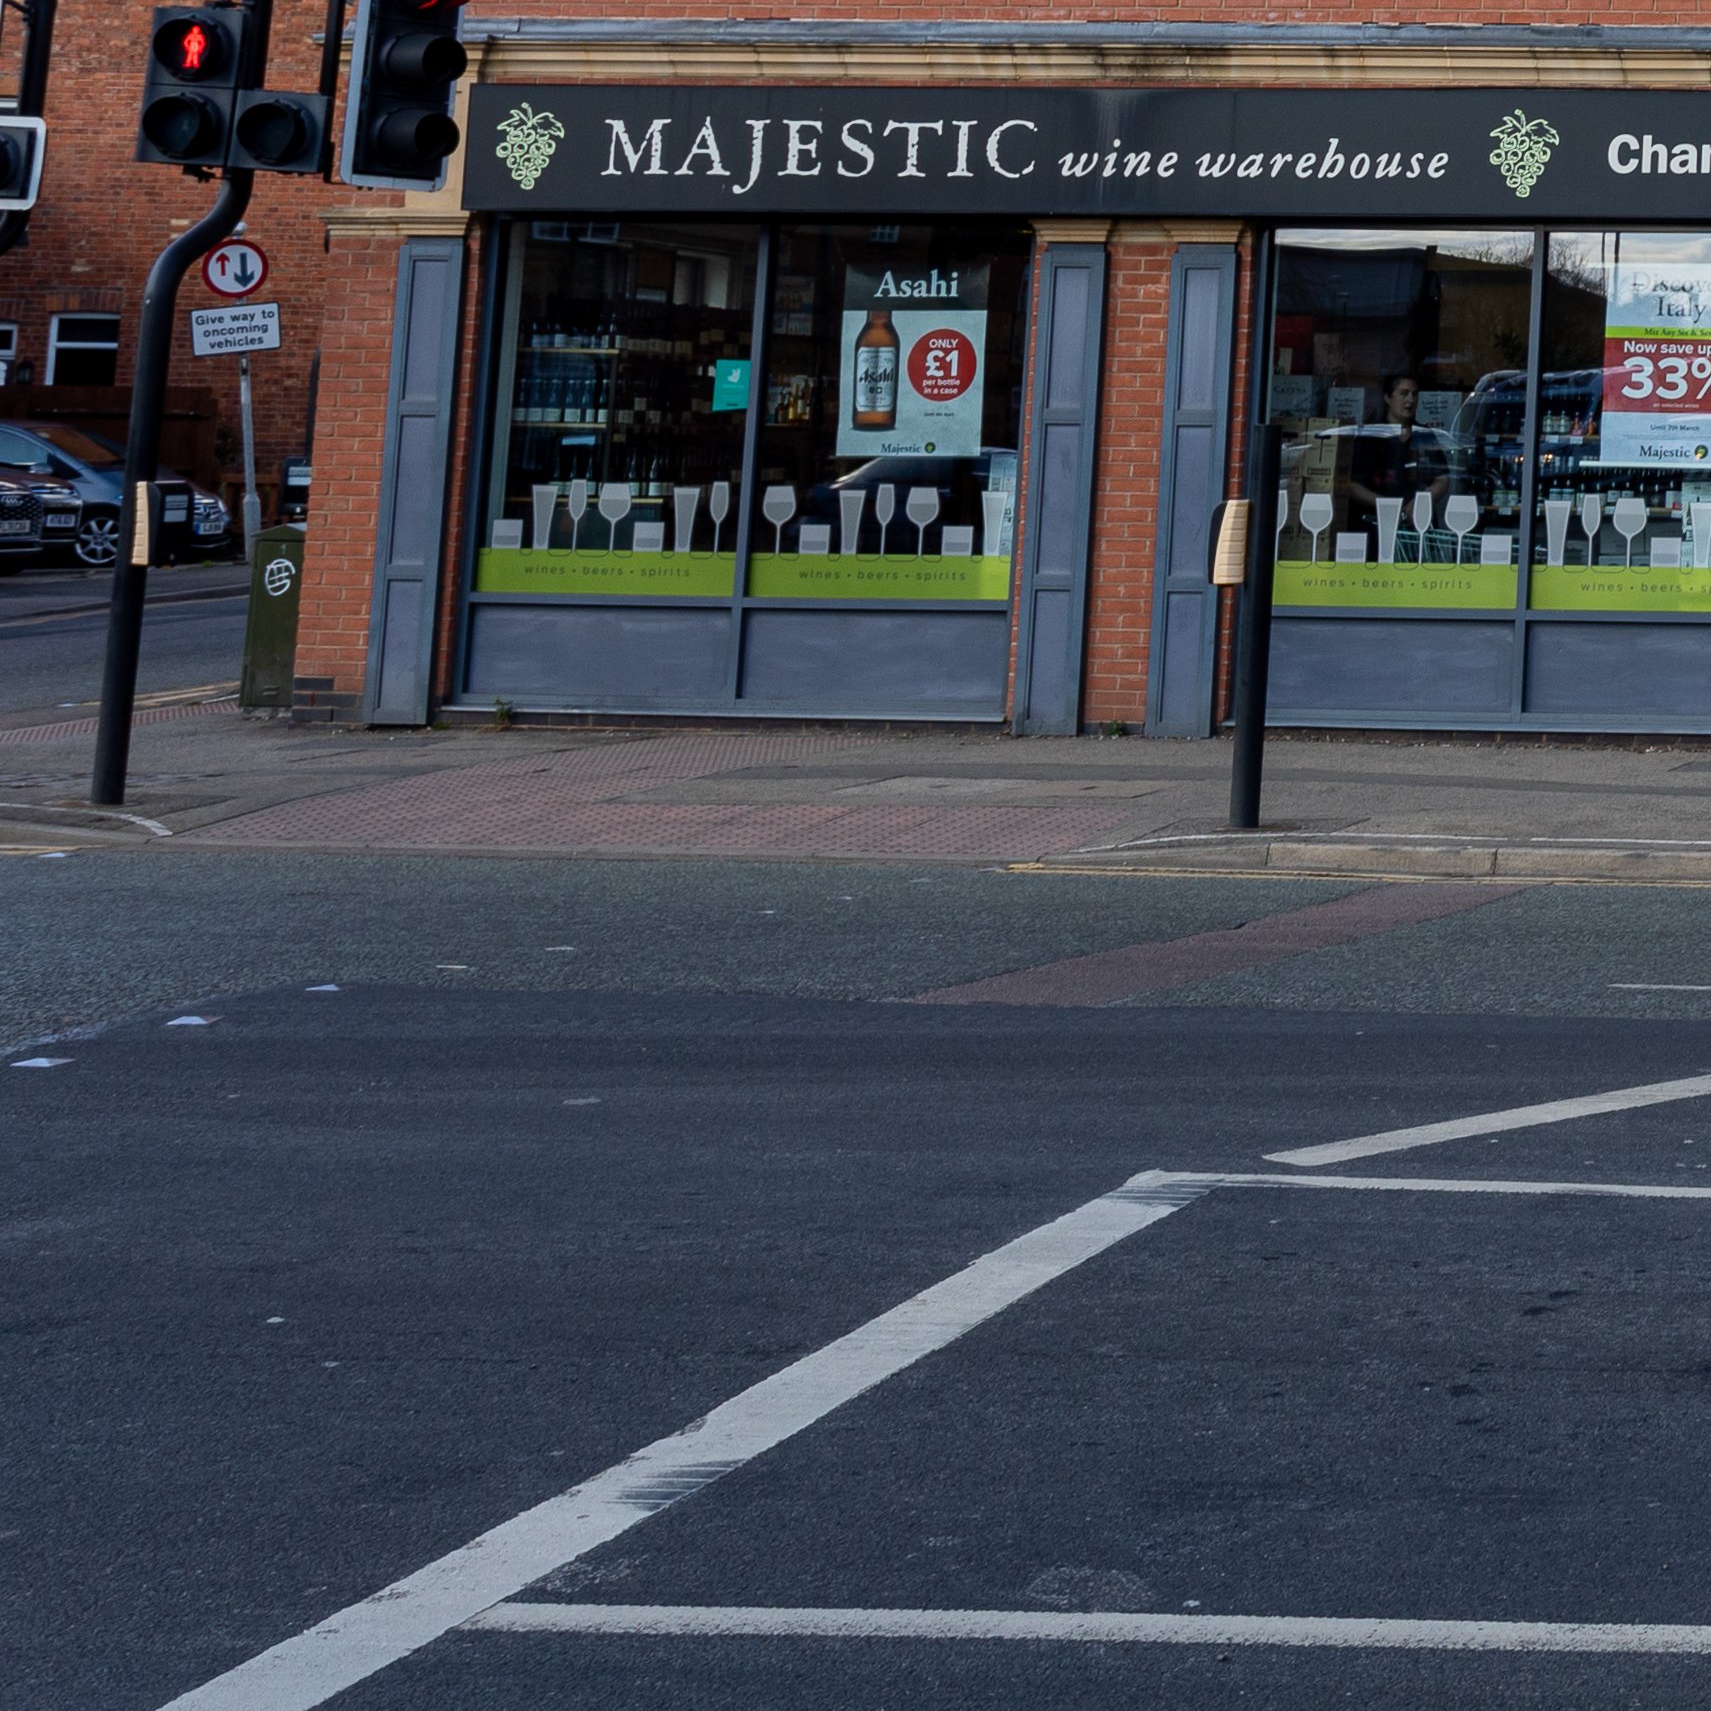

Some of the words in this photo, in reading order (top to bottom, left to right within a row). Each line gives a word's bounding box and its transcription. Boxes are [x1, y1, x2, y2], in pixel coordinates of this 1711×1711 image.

[600, 115, 1038, 194] MAJESTIC
[1057, 138, 1179, 177] wine
[1195, 137, 1449, 179] warehouse
[873, 268, 959, 298] Asahi
[1657, 296, 1707, 324] Italy
[195, 314, 224, 326] Give
[230, 312, 256, 322] way
[261, 309, 275, 319] to
[203, 323, 269, 338] oncoming
[209, 335, 264, 349] vehicles
[929, 338, 959, 349] ONLY
[1623, 340, 1657, 354] Now
[1660, 343, 1694, 354] save
[925, 350, 960, 378] £1
[922, 379, 936, 387] per
[937, 378, 960, 386] bottle
[880, 443, 921, 455] Majestic
[1639, 445, 1690, 460] Majestic
[524, 565, 565, 575] wines
[583, 565, 624, 575] beers
[641, 566, 690, 577] spirits
[799, 569, 841, 580] wines
[857, 570, 899, 580] beers
[916, 570, 966, 582] spirits
[1303, 578, 1345, 587] wines
[1363, 578, 1404, 588] beers
[1422, 579, 1472, 590] spirits
[1581, 583, 1623, 592] wines
[1641, 583, 1682, 592] beers
